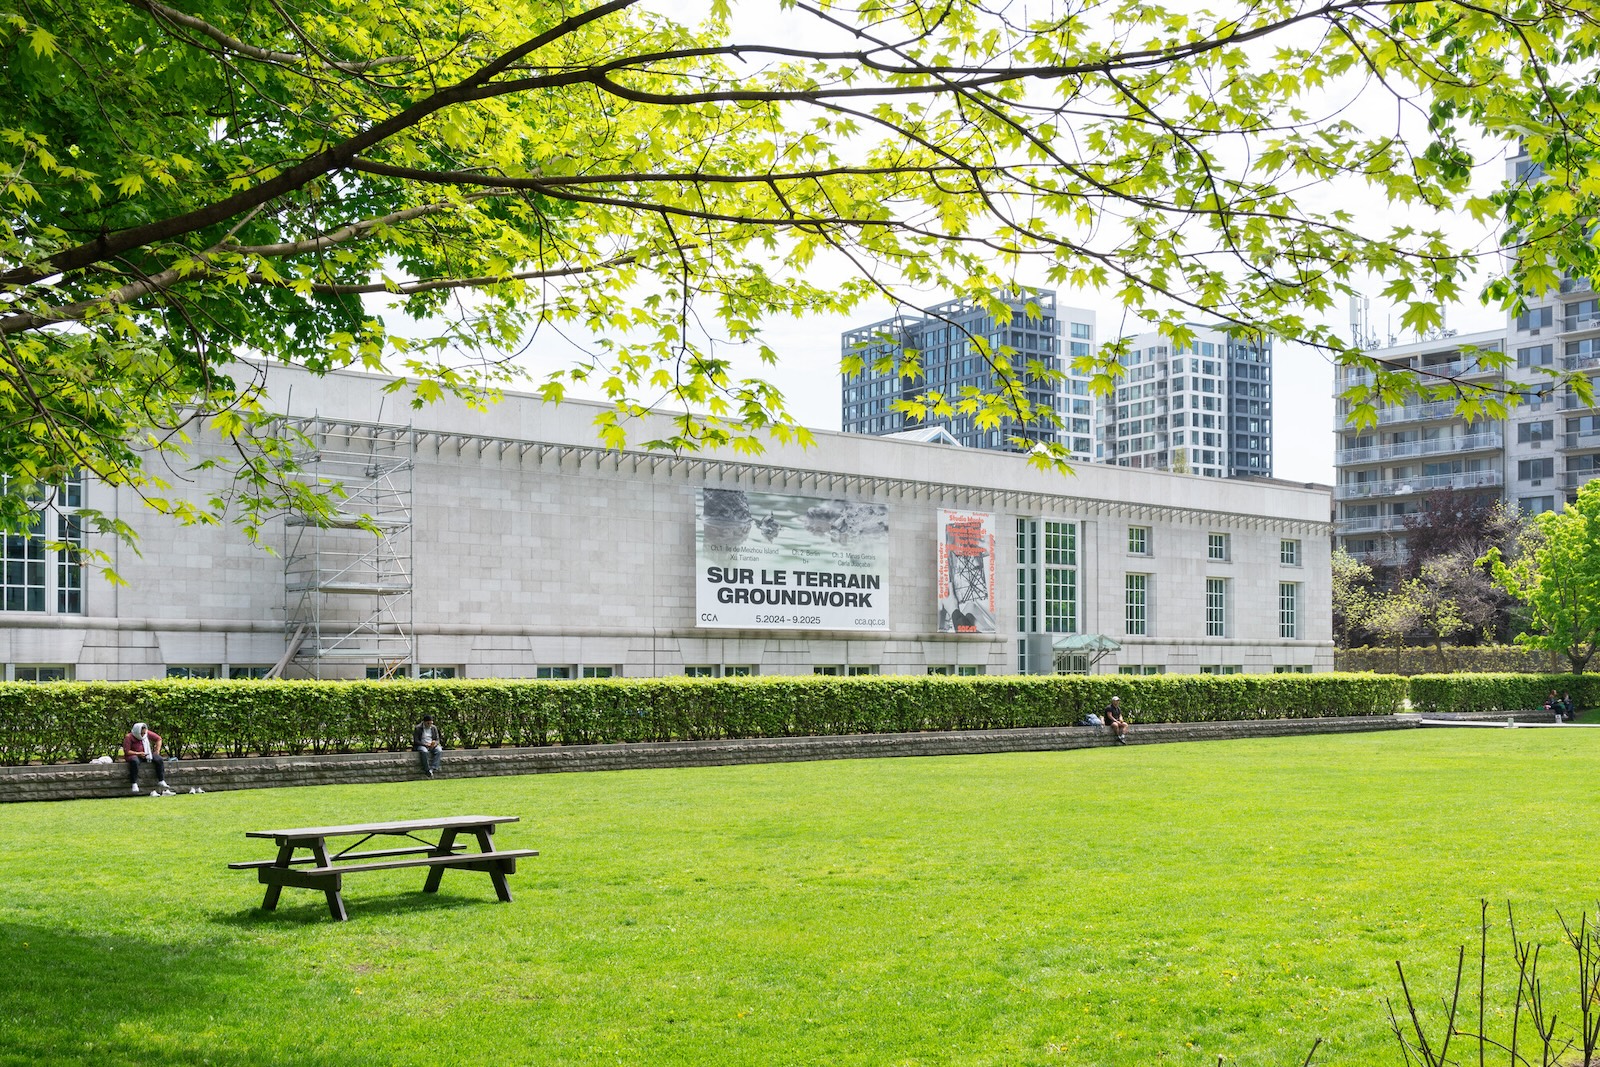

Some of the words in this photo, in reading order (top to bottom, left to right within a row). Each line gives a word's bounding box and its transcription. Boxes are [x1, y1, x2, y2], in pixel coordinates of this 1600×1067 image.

[939, 566, 944, 575] du
[707, 566, 754, 584] SUR
[761, 570, 786, 585] LE
[793, 571, 880, 589] TERRAIN
[717, 587, 872, 608] GROUNDWORK
[701, 613, 718, 622] CCA
[855, 618, 885, 627] cca.qc.ca
